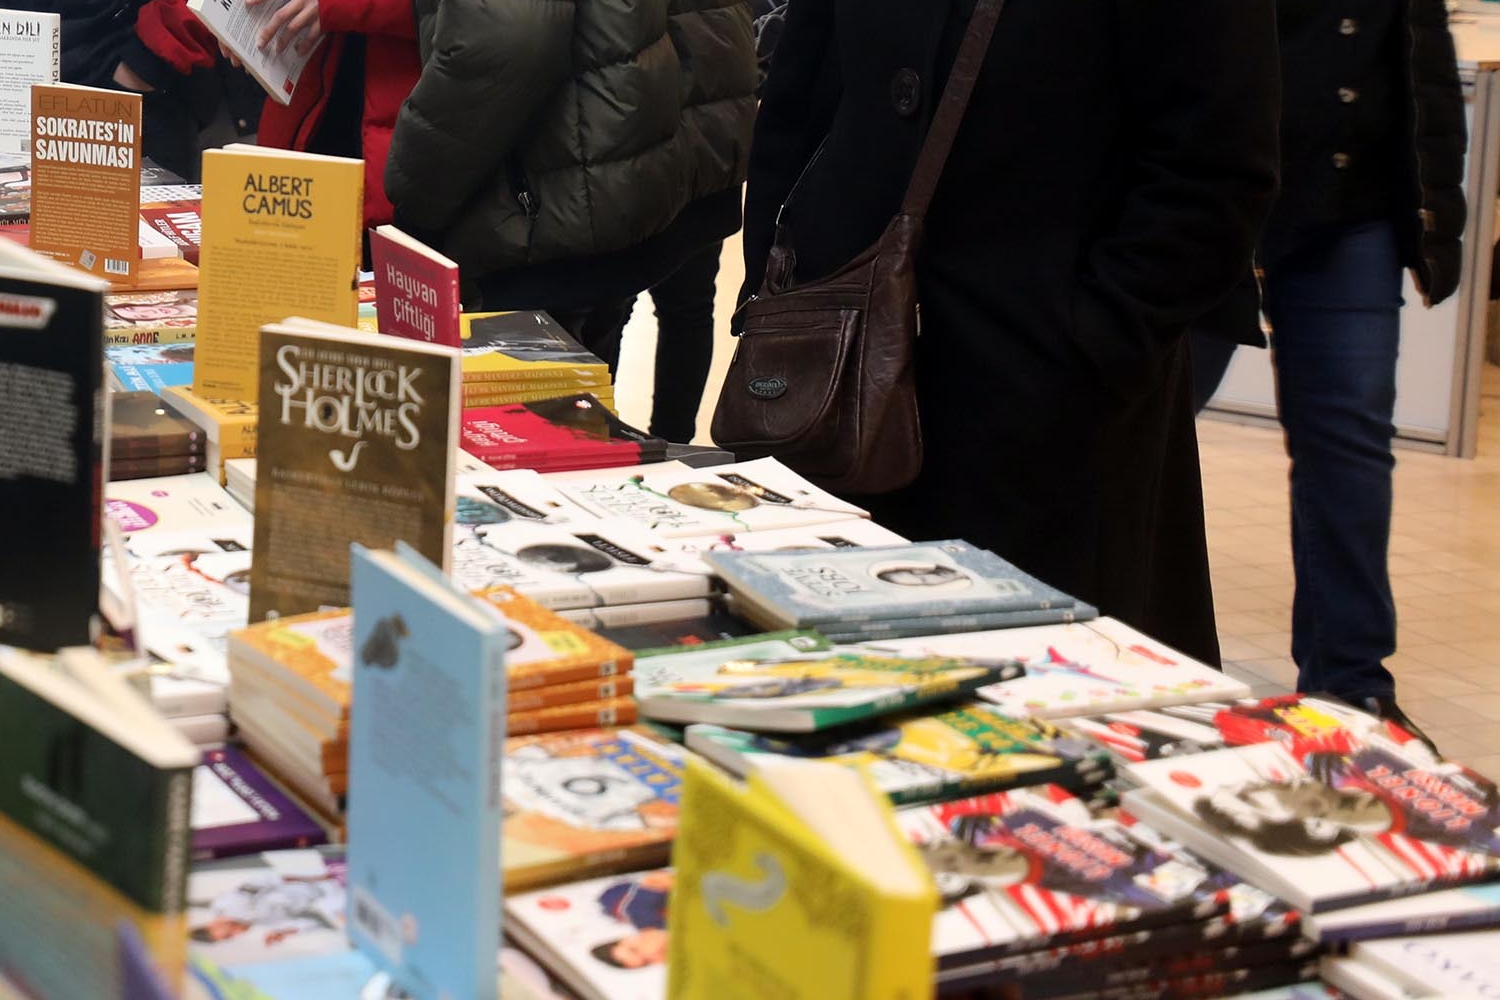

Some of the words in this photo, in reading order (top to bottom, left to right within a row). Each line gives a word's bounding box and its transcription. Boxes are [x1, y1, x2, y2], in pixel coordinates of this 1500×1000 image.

[38, 94, 133, 117] EFLATUN
[36, 116, 134, 144] SOKRATES'İN
[35, 138, 134, 169] SAVUNMASI
[243, 173, 314, 197] ALBERT
[242, 194, 313, 219] CAMUS
[386, 263, 438, 309] Hayvan
[393, 296, 436, 342] Çiftliği
[132, 331, 160, 345] ANNE
[273, 344, 426, 411] SHERLOCK
[280, 384, 421, 451] HOLMES
